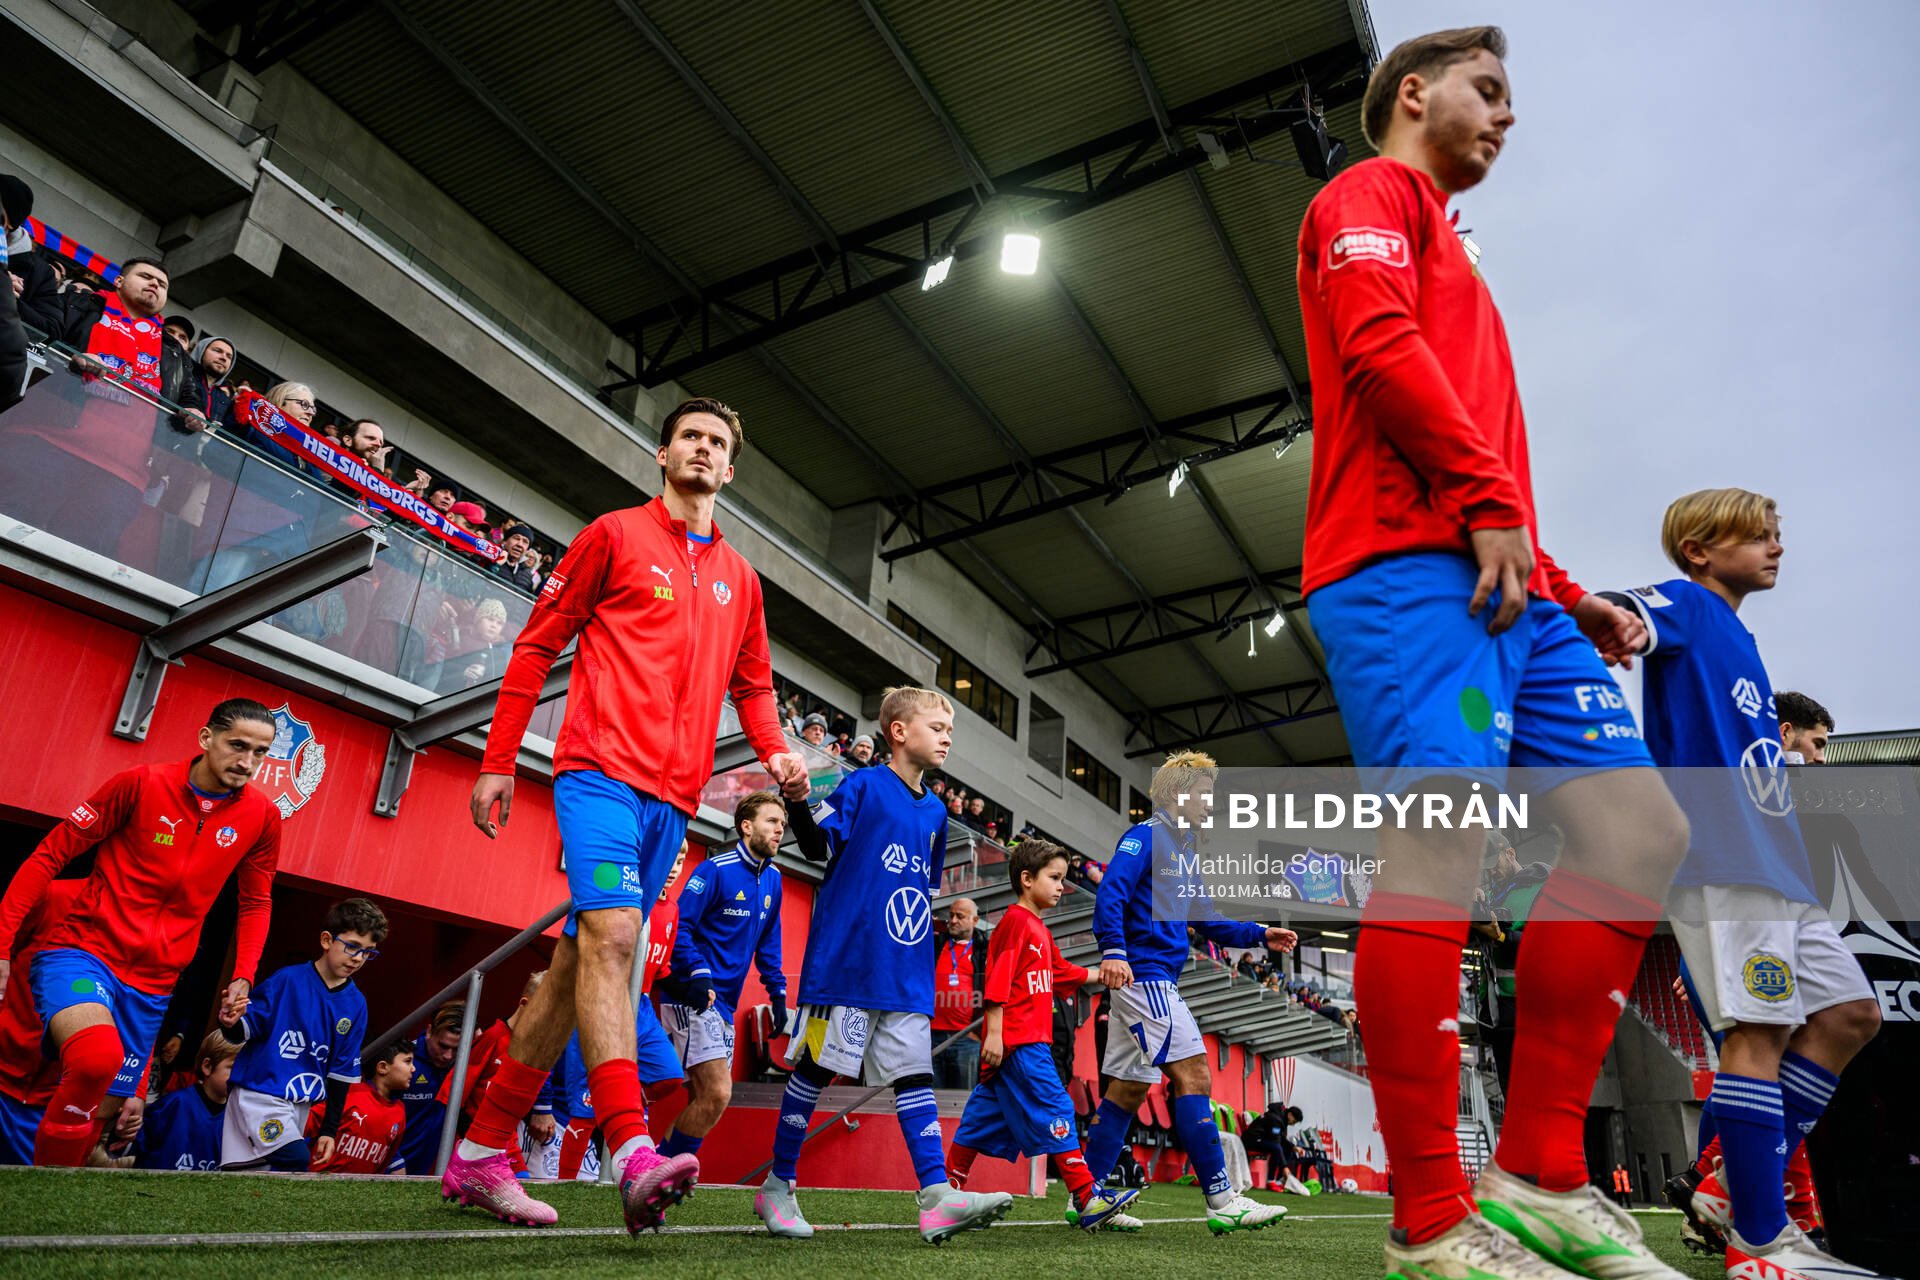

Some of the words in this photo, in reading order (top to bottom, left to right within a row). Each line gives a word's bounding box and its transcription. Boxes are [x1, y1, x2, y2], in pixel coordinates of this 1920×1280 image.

[302, 432, 439, 526] HELSINGBORGS
[442, 517, 461, 537] IF
[653, 586, 675, 601] XXL
[153, 832, 175, 846] XXL
[722, 907, 751, 918] stadium
[337, 1134, 368, 1160] FAIR
